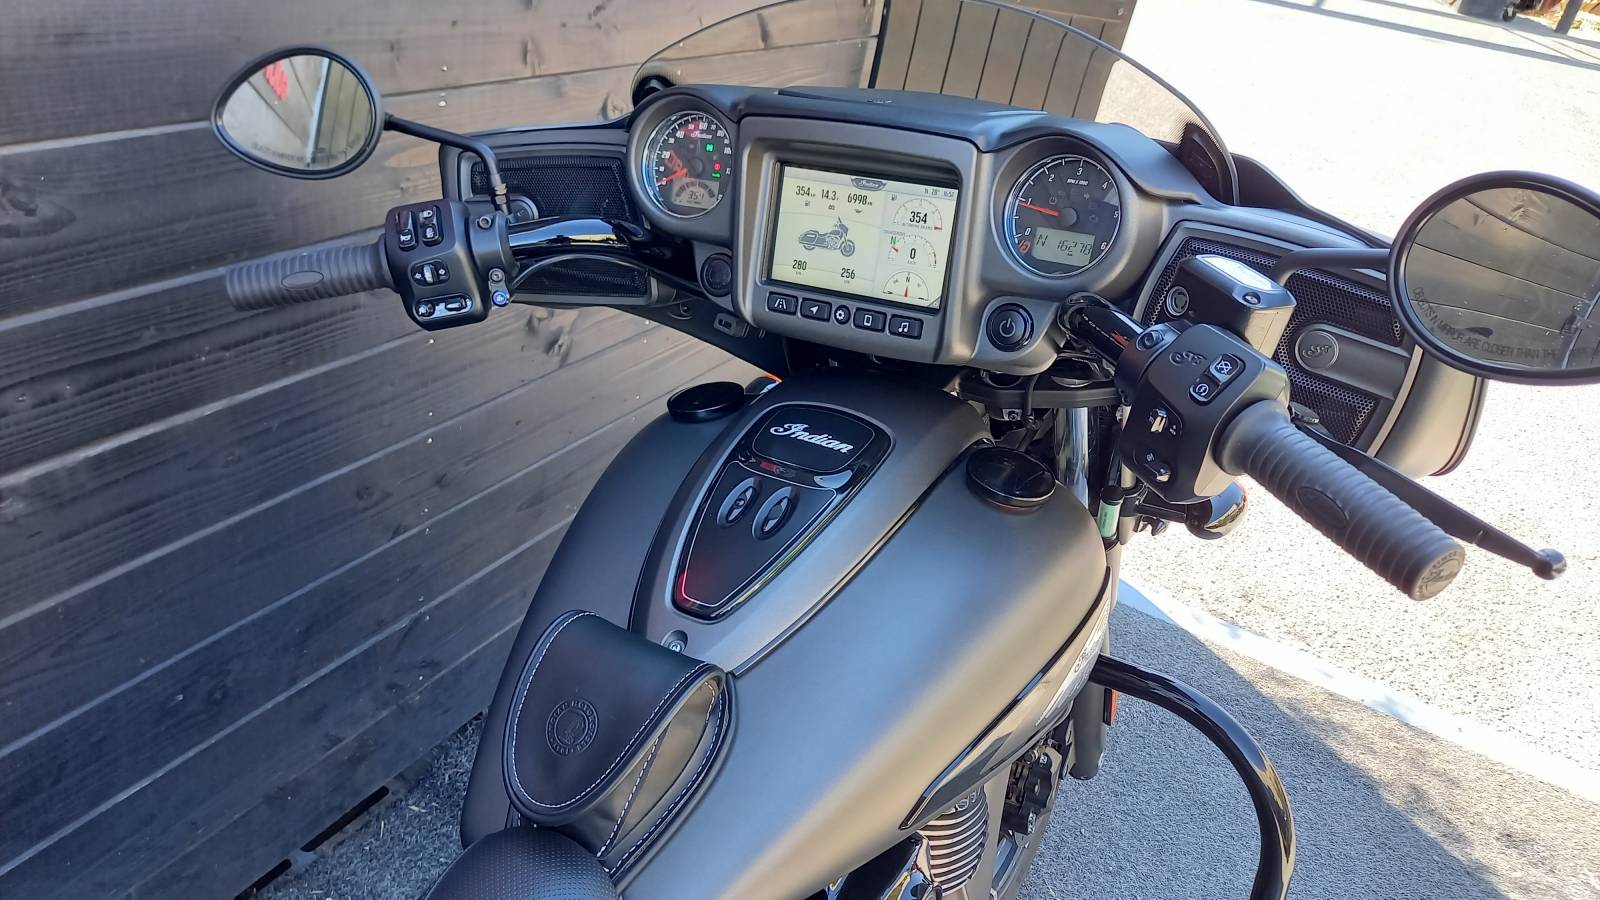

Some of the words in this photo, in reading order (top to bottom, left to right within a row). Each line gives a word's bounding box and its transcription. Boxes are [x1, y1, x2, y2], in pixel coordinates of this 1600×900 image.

[795, 185, 811, 198] 354
[847, 193, 868, 206] 6998
[909, 211, 928, 225] 354
[1036, 234, 1048, 248] N
[792, 259, 808, 271] 280
[840, 268, 856, 280] 256
[770, 423, 854, 454] Indian
